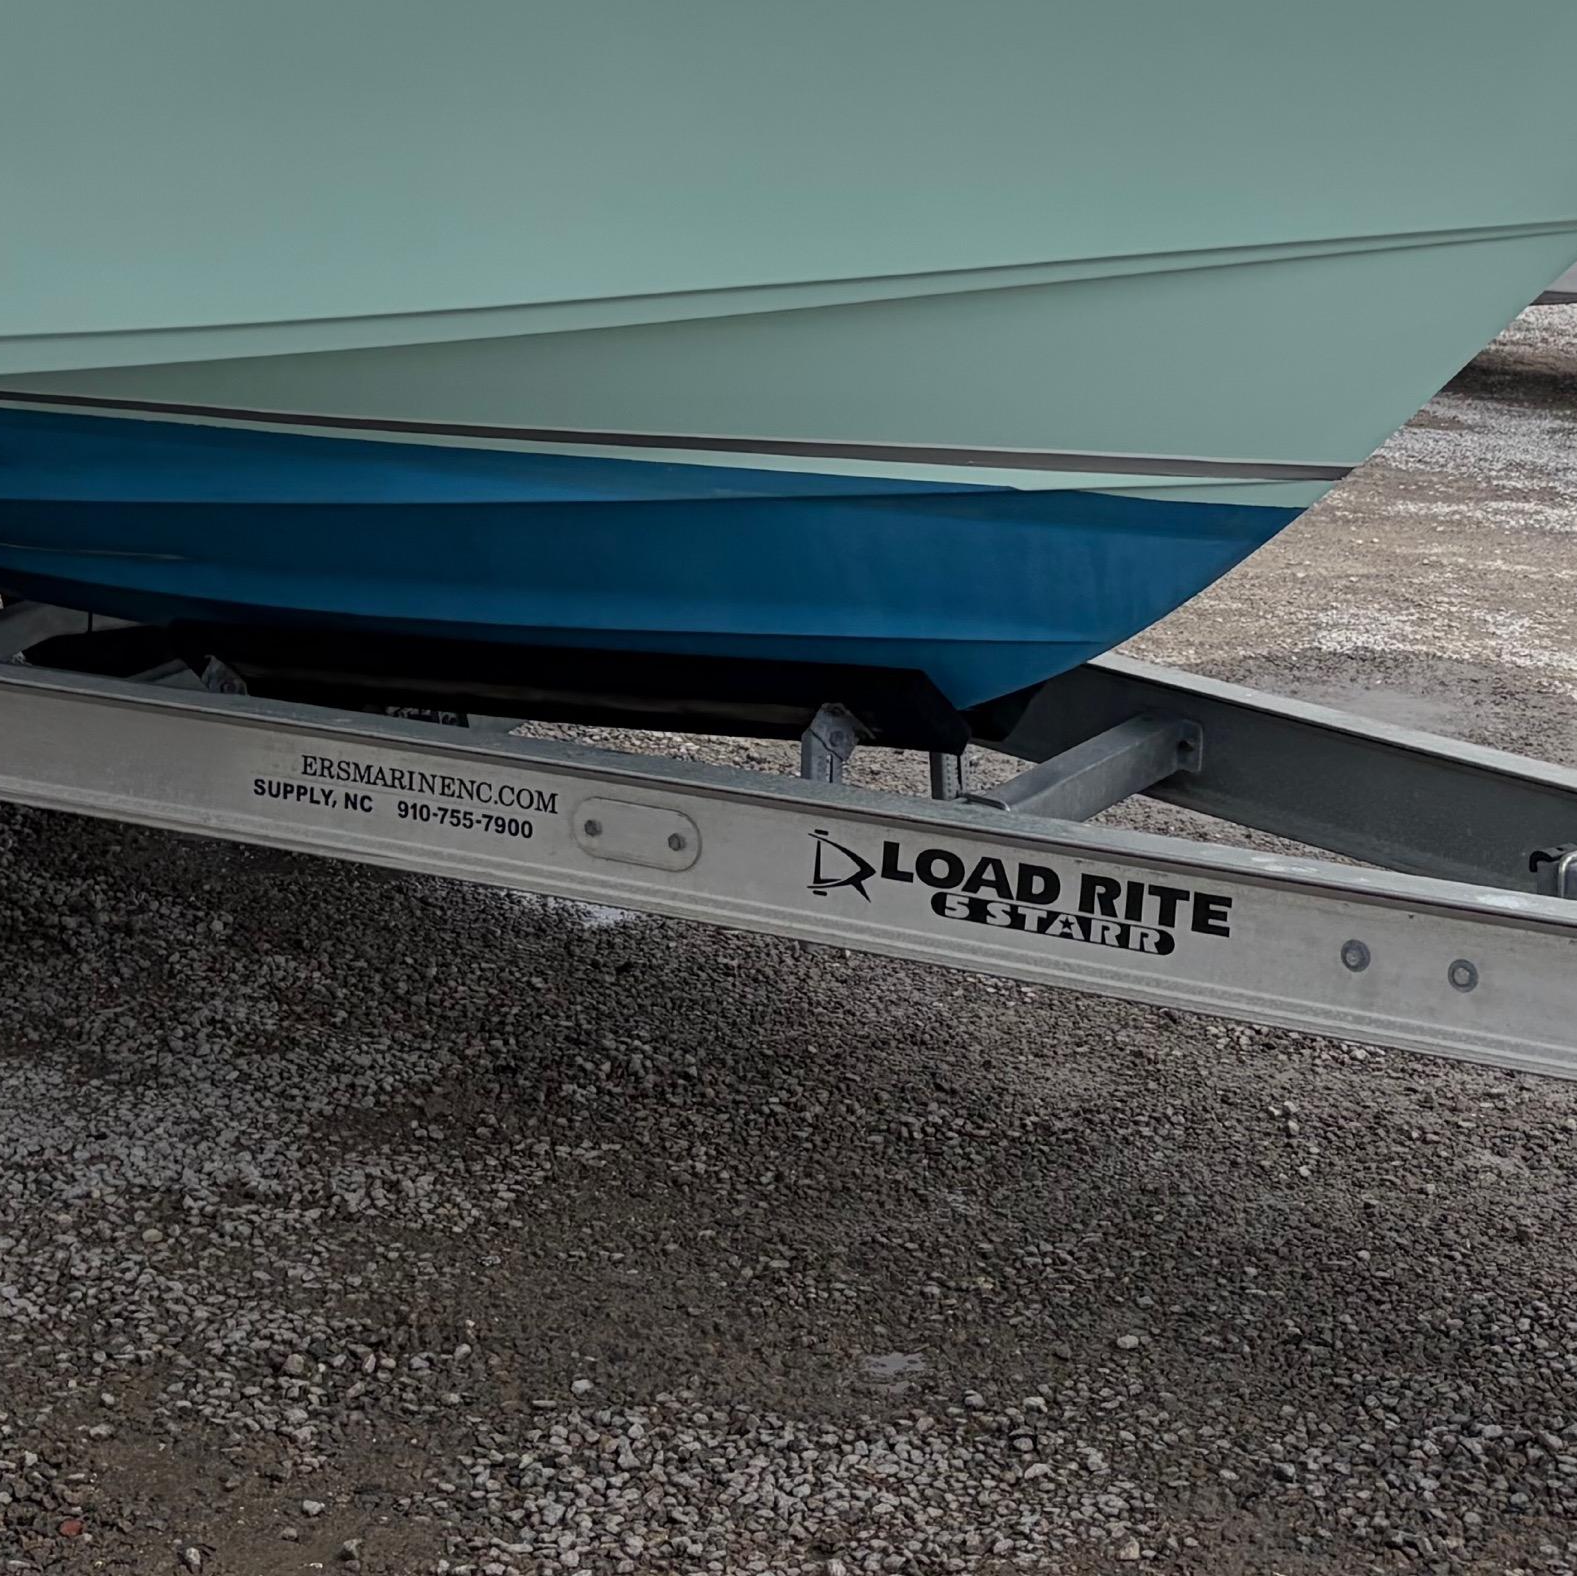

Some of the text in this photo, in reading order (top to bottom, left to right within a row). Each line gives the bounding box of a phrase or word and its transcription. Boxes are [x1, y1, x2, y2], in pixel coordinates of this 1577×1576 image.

[253, 778, 534, 839] SUPPLY, NC 910-755-7900
[301, 754, 559, 815] ERSMARINENC.COM
[880, 840, 1233, 938] LOAD RITE
[943, 895, 1162, 955] 5 STARR
